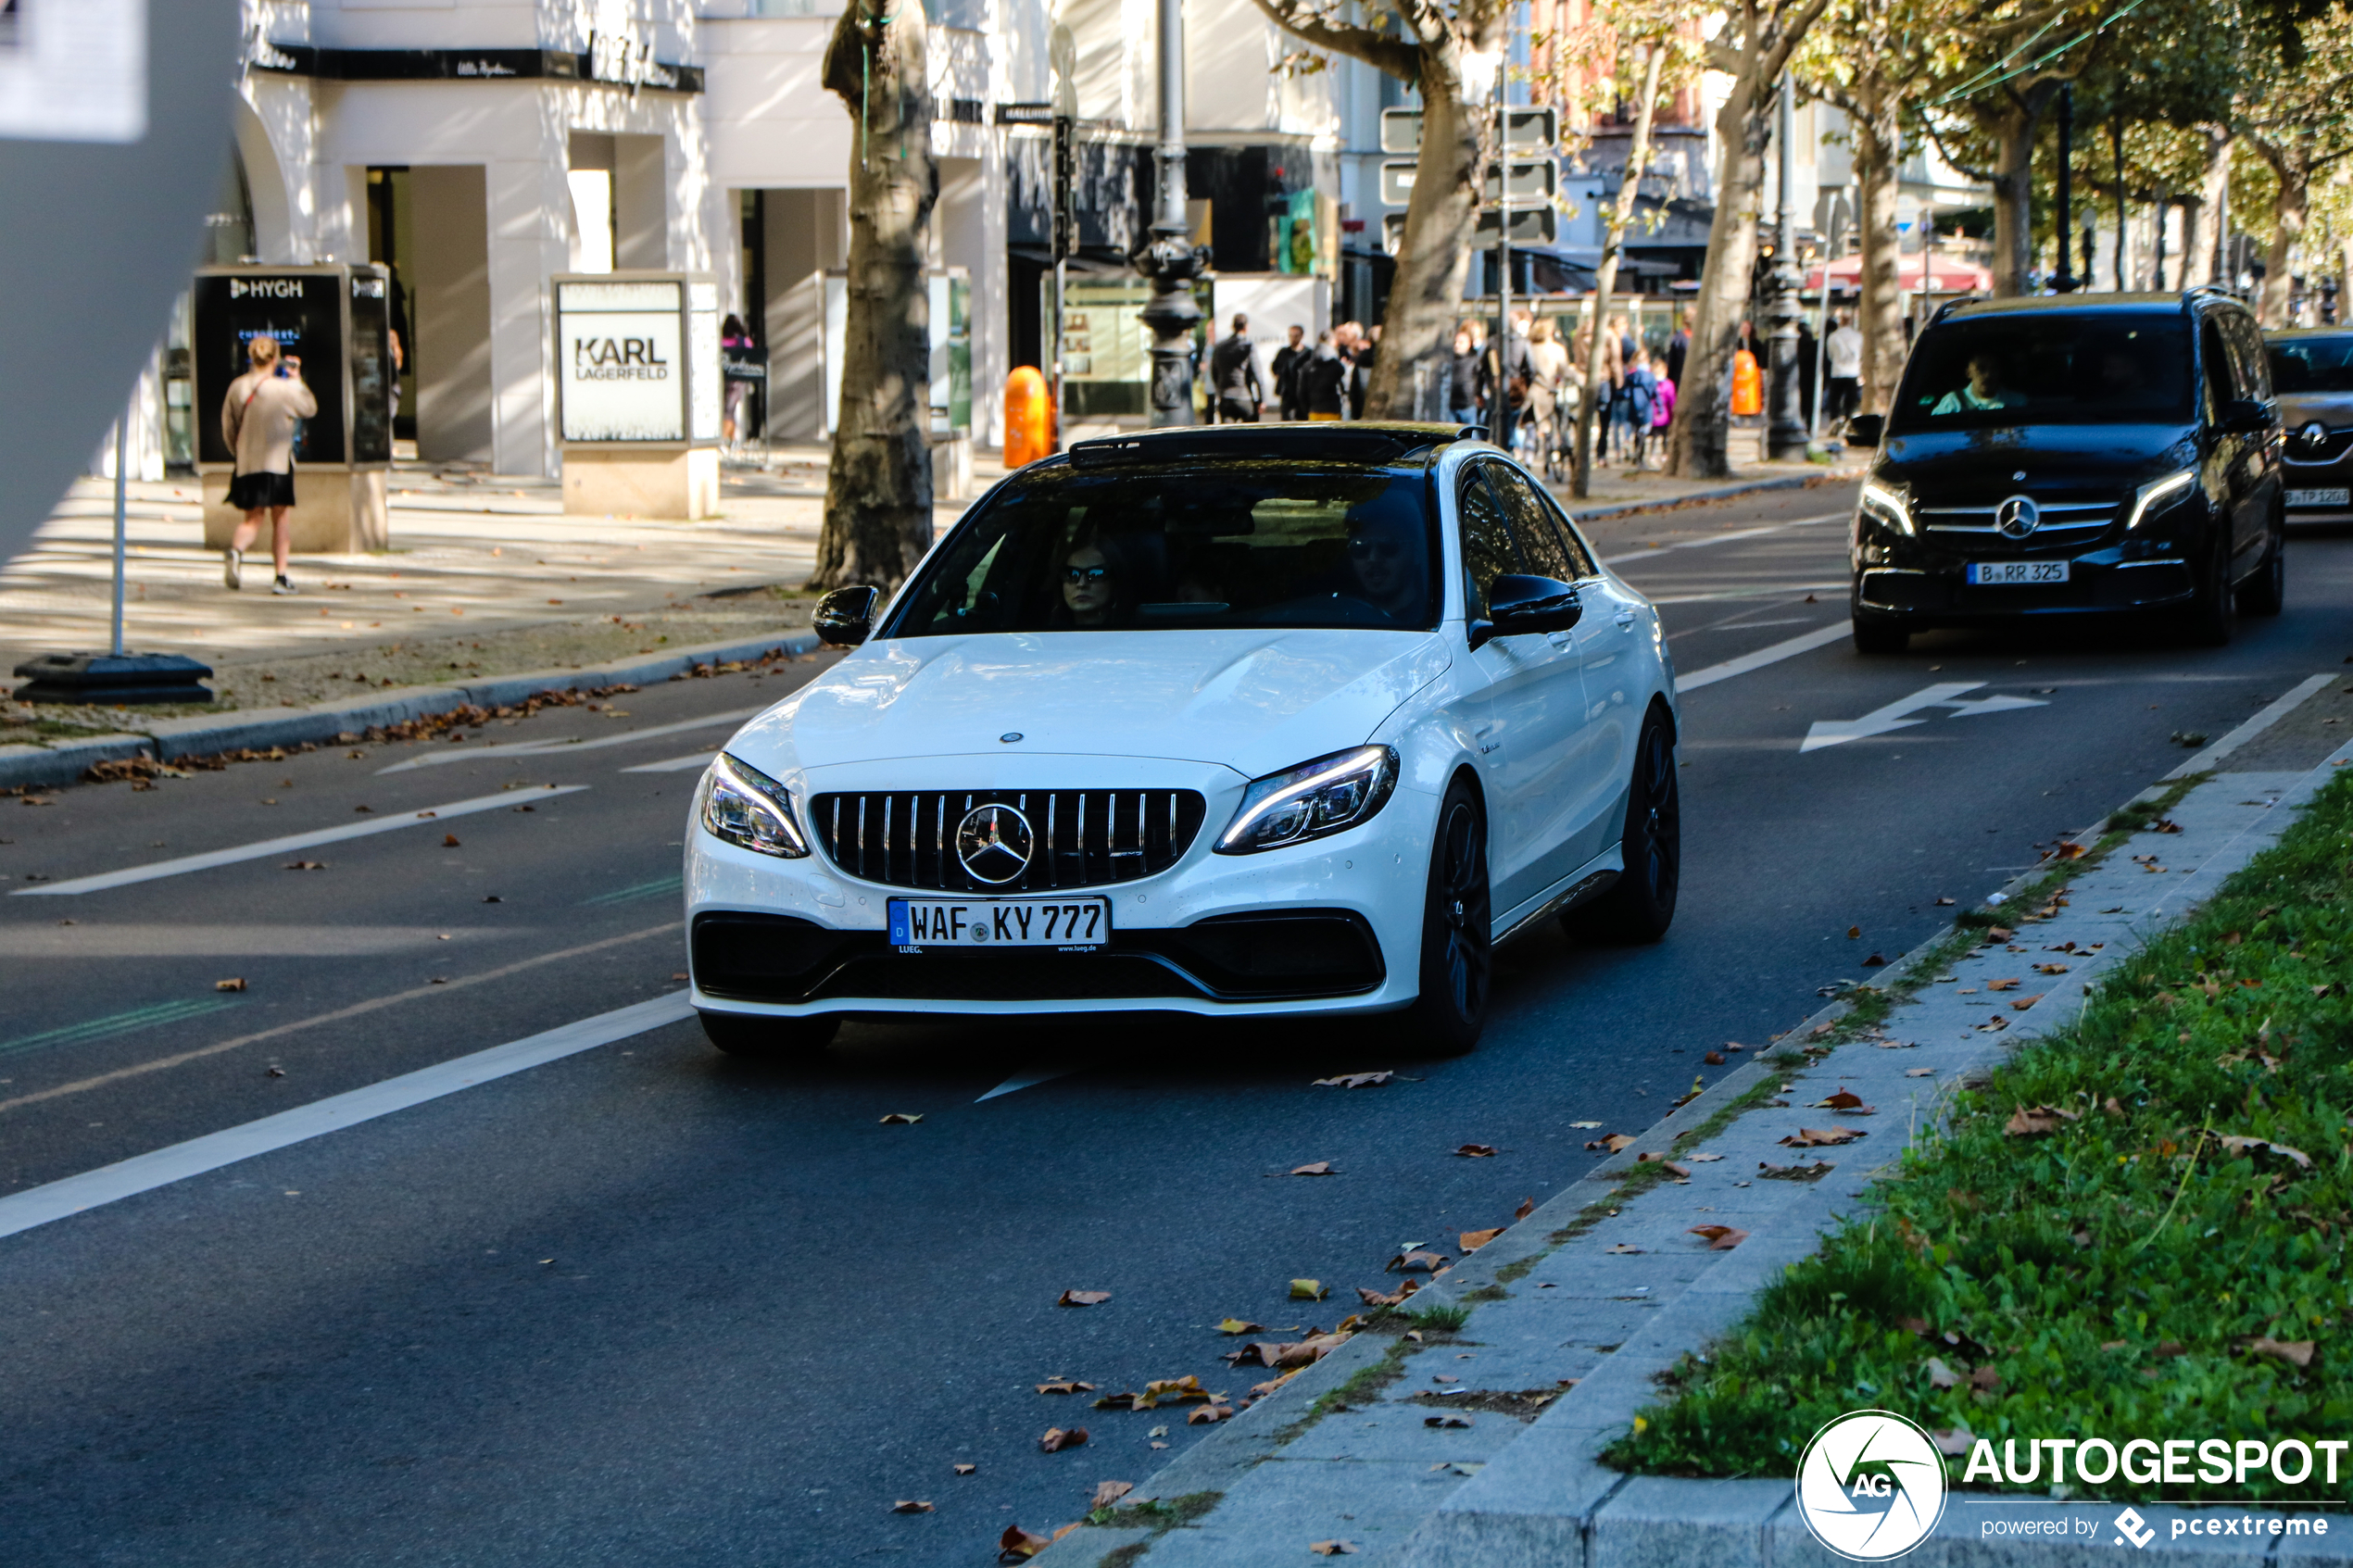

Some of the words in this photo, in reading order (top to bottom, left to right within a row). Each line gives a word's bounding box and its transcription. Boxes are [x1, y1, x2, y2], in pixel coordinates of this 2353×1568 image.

[250, 280, 304, 297] HYGH
[575, 337, 667, 367] KARL
[575, 368, 668, 381] LAGERFELD
[1982, 566, 1993, 583] B
[2005, 565, 2027, 582] RR
[2032, 564, 2062, 581] 325
[911, 906, 967, 940] WAF
[993, 906, 1033, 940] KY
[1042, 905, 1101, 939] 777
[896, 927, 903, 937] D
